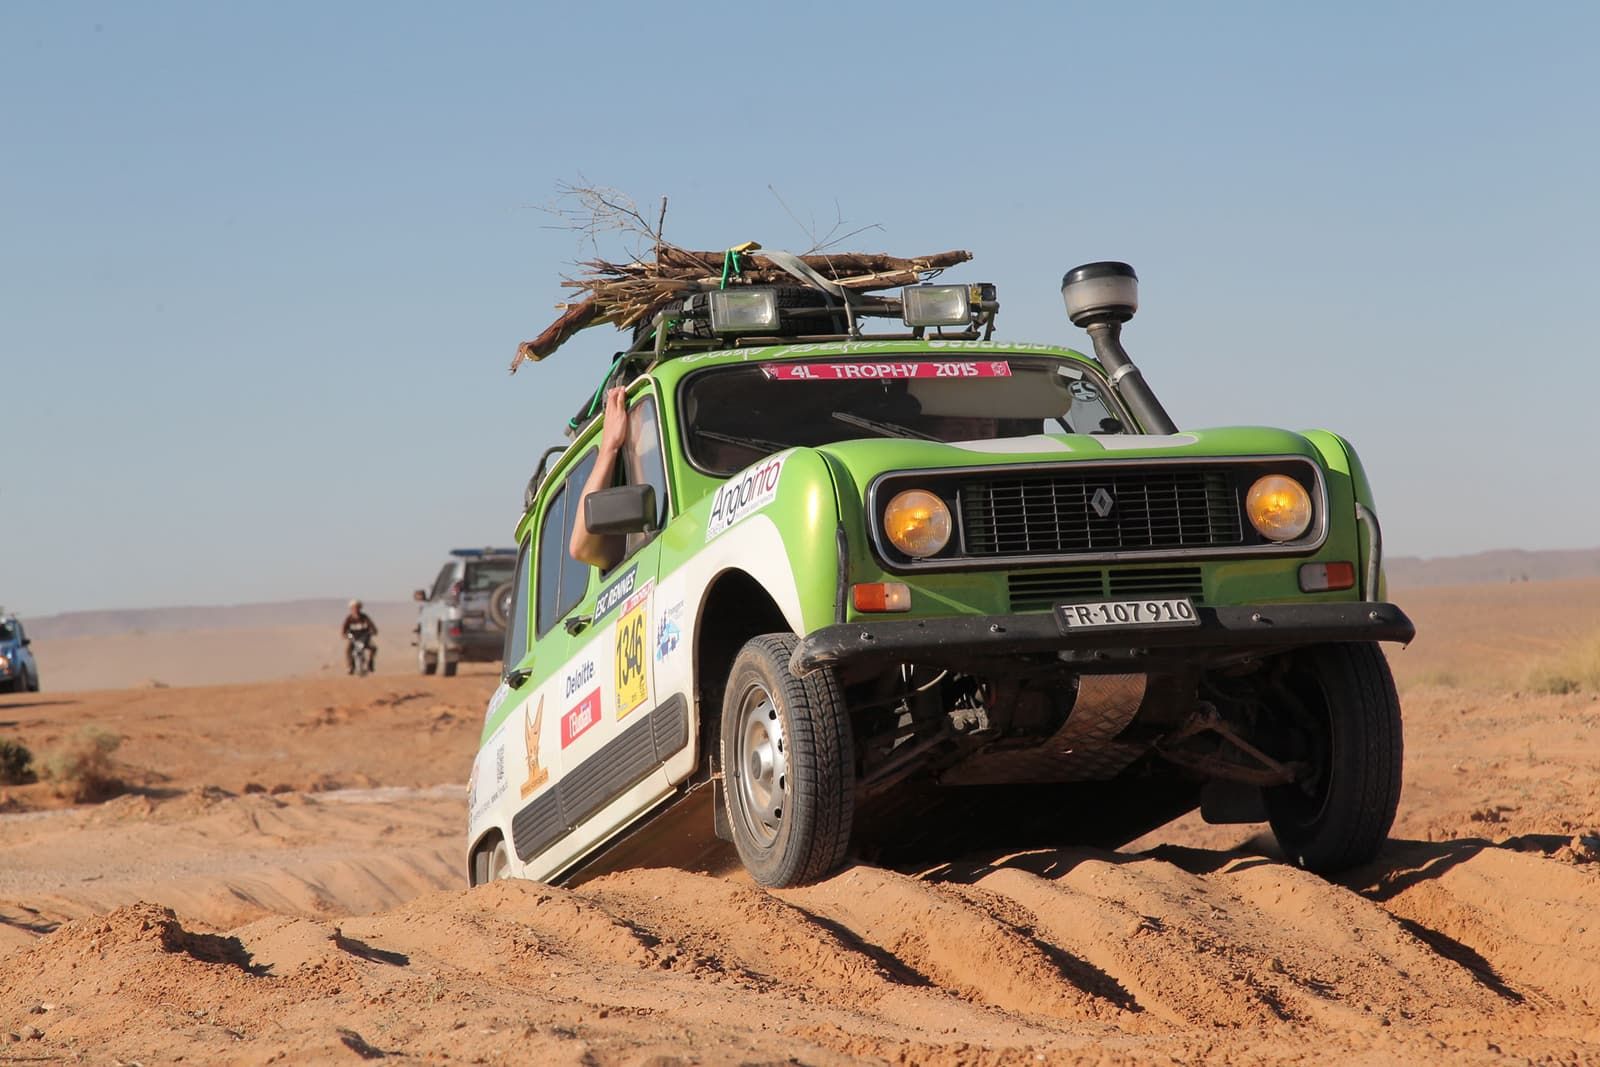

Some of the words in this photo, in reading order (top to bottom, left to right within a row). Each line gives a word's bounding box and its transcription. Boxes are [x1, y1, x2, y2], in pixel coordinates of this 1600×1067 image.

[790, 363, 819, 379] 4L
[830, 363, 918, 380] TROPHY
[932, 361, 979, 378] 2015
[594, 592, 609, 620] ESC
[616, 614, 643, 689] 1346
[565, 661, 595, 699] Deloitte
